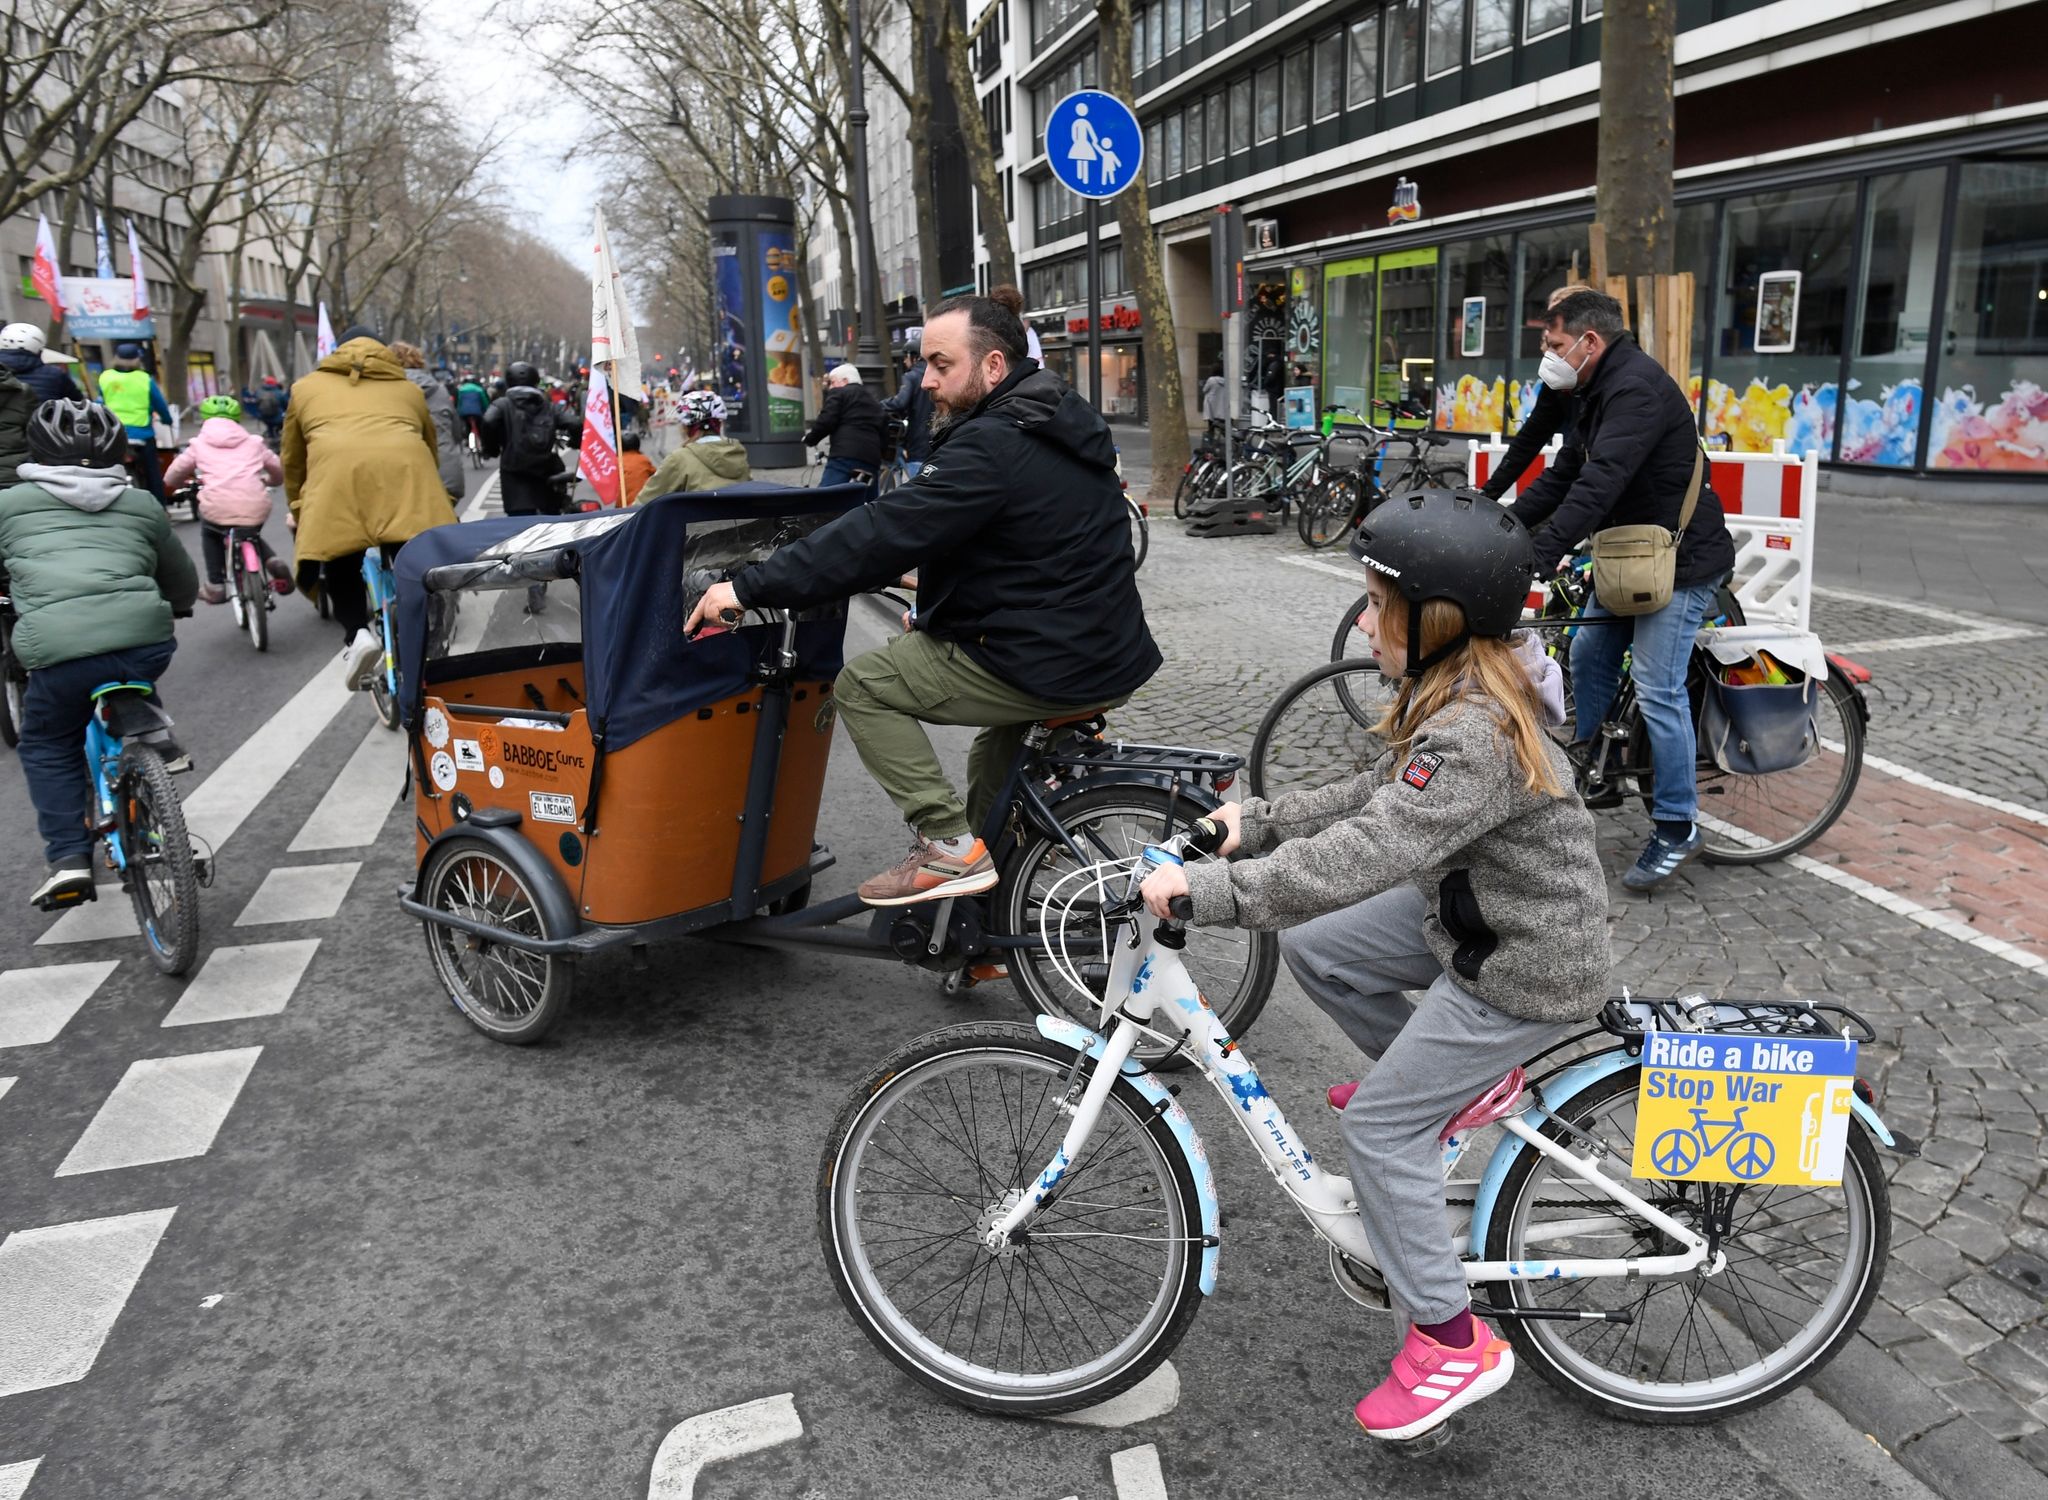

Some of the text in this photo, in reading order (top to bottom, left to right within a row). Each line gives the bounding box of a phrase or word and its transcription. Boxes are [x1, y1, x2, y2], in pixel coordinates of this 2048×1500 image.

[588, 439, 617, 476] MASS
[503, 741, 558, 772] BABBOE
[533, 802, 573, 817] EL MEDANO
[1650, 1038, 1814, 1073] Ride a bike
[1647, 1071, 1715, 1106] Stop
[1726, 1075, 1783, 1103] War
[1263, 1118, 1312, 1181] FALTER
